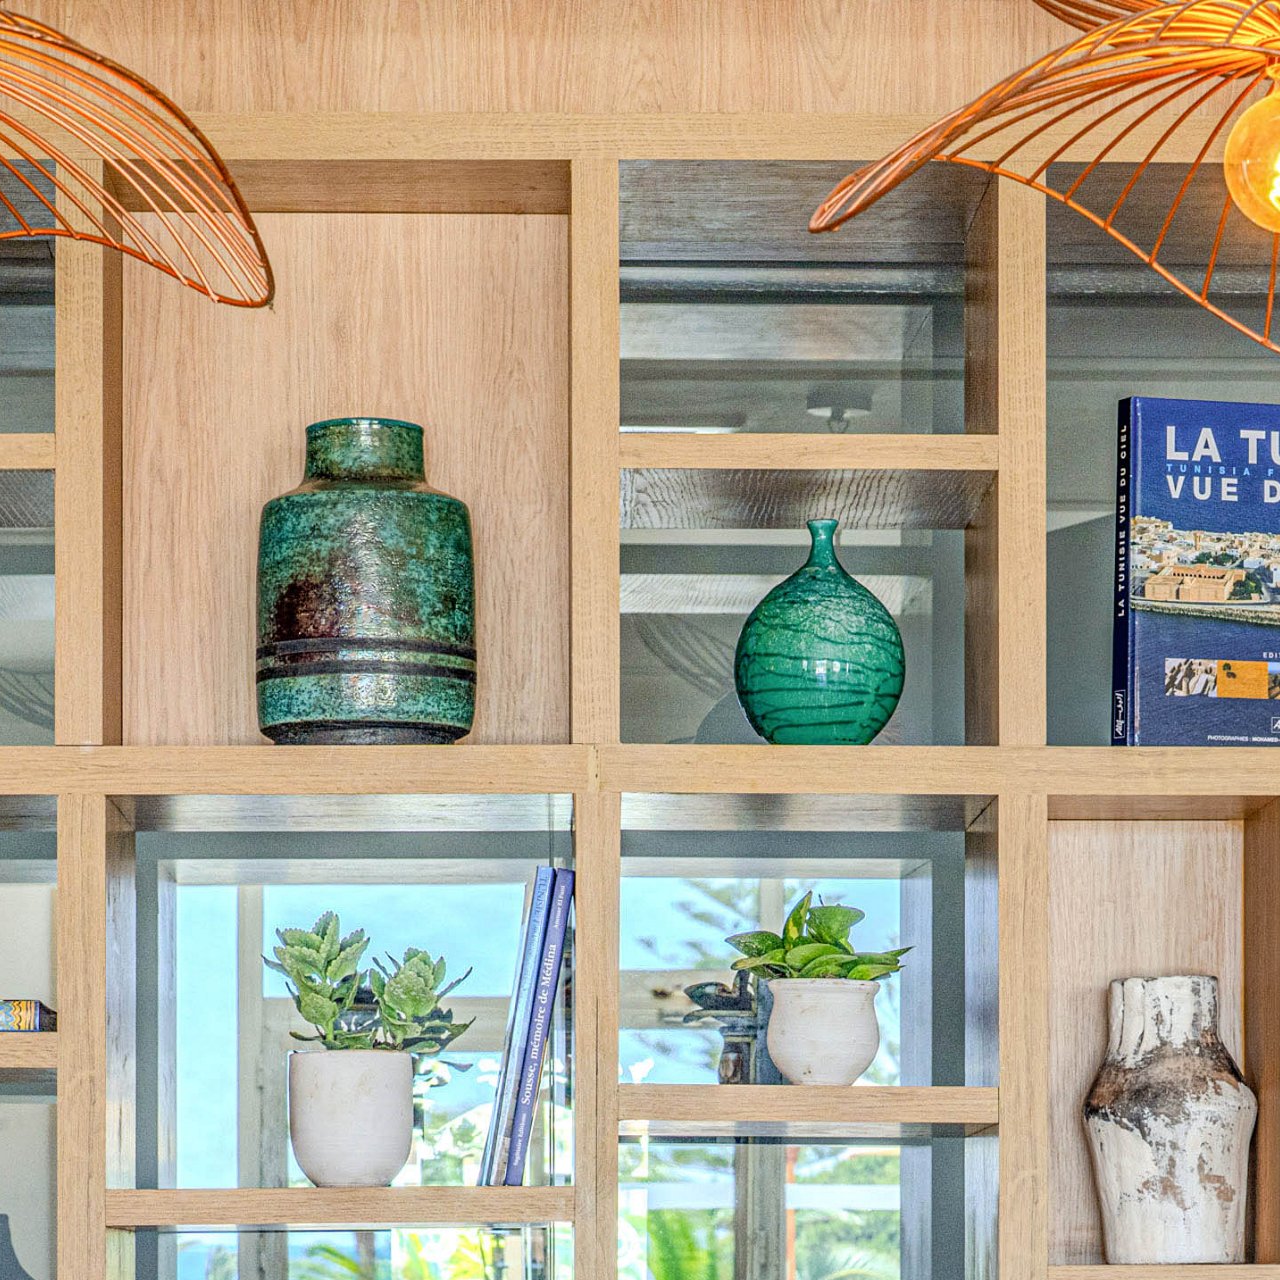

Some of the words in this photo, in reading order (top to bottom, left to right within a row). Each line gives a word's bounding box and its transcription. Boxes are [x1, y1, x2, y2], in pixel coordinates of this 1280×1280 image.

[1166, 425, 1222, 463] LA
[1120, 467, 1126, 486] DU
[1166, 463, 1251, 477] TUNISIA
[1166, 474, 1239, 502] VUE
[1118, 530, 1126, 591] TUNISIE
[1118, 599, 1125, 616] LA
[541, 944, 557, 988] Médina
[538, 989, 548, 1004] de
[530, 1006, 546, 1060] mémoire
[521, 1063, 538, 1106] Sousse,
